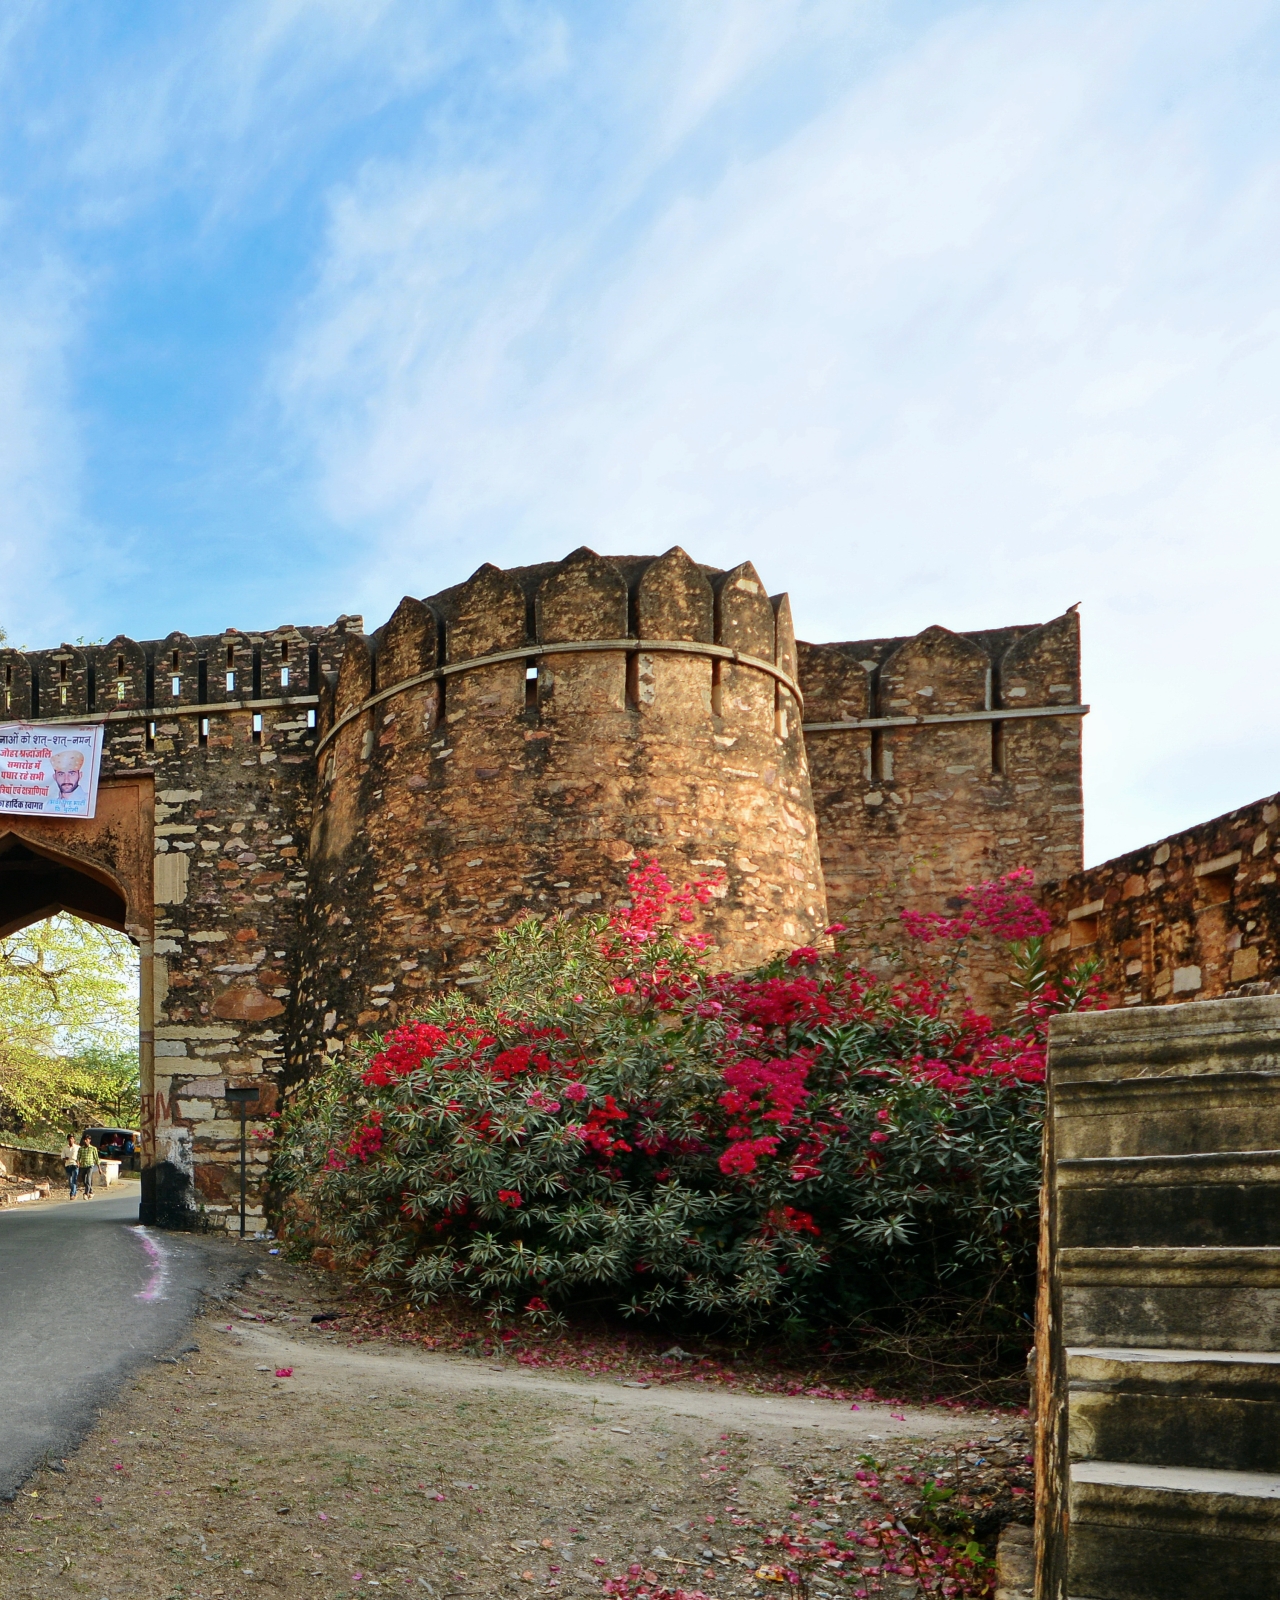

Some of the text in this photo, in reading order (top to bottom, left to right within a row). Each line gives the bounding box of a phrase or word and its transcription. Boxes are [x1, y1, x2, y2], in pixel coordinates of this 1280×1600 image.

[20, 732, 31, 744] को
[34, 760, 42, 769] में
[19, 771, 29, 780] रहे
[29, 772, 44, 781] सभी
[5, 798, 23, 808] हार्दिक
[24, 801, 43, 810] स्वागत
